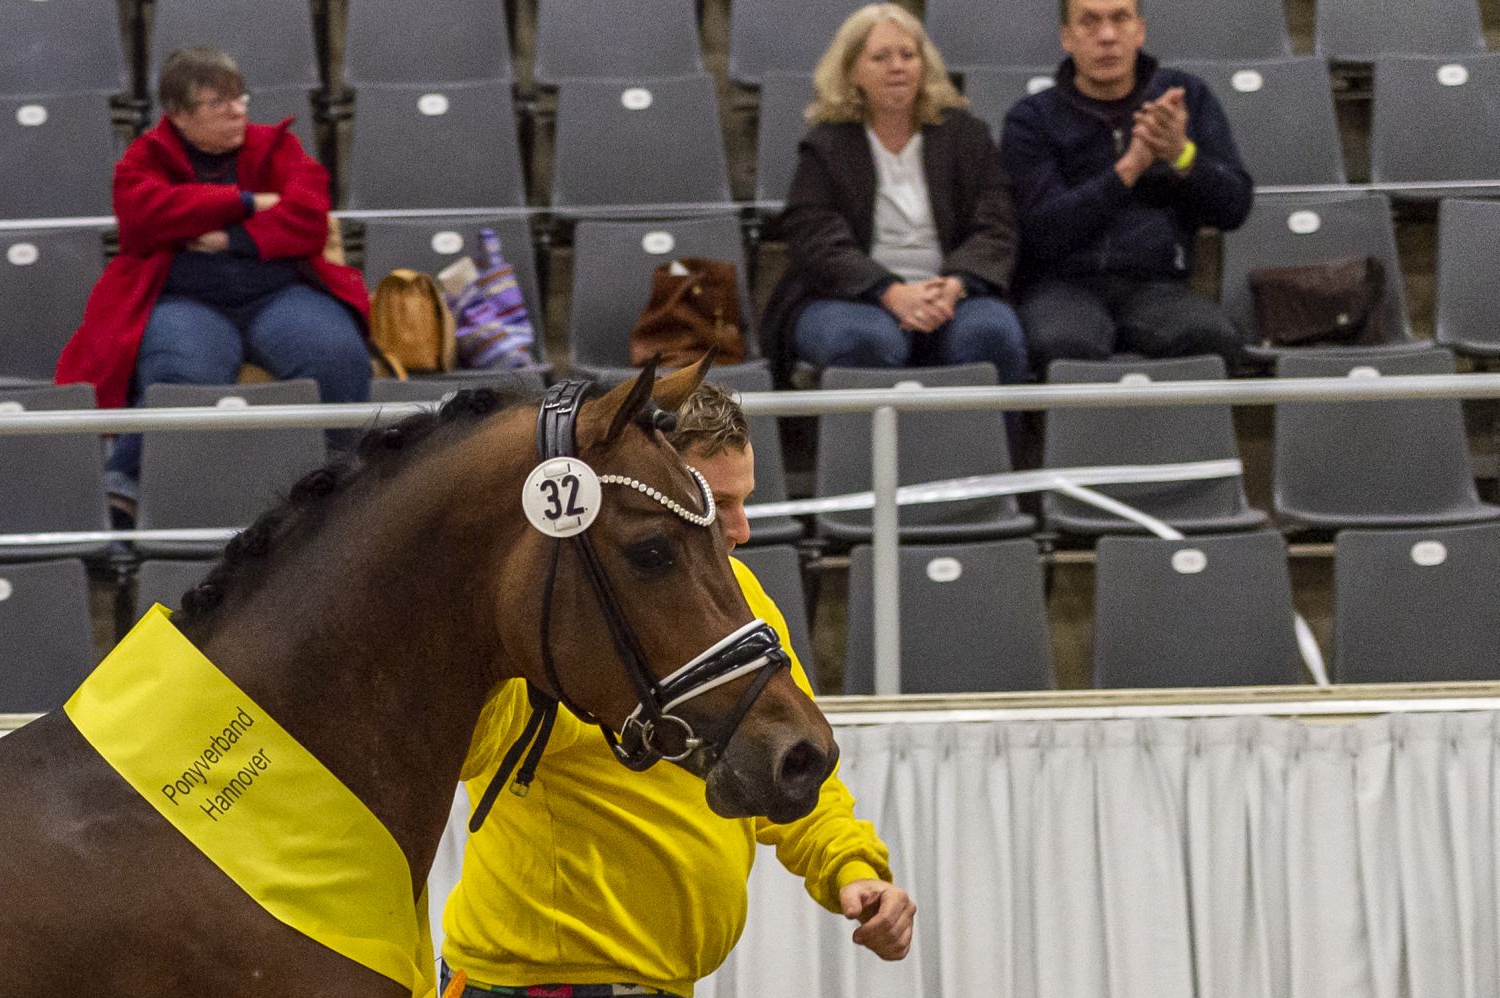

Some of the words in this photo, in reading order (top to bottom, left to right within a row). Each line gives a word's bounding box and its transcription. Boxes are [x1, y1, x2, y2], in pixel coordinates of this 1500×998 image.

[540, 475, 584, 520] 32
[161, 706, 255, 806] Ponyverband
[200, 748, 272, 822] Hannover
